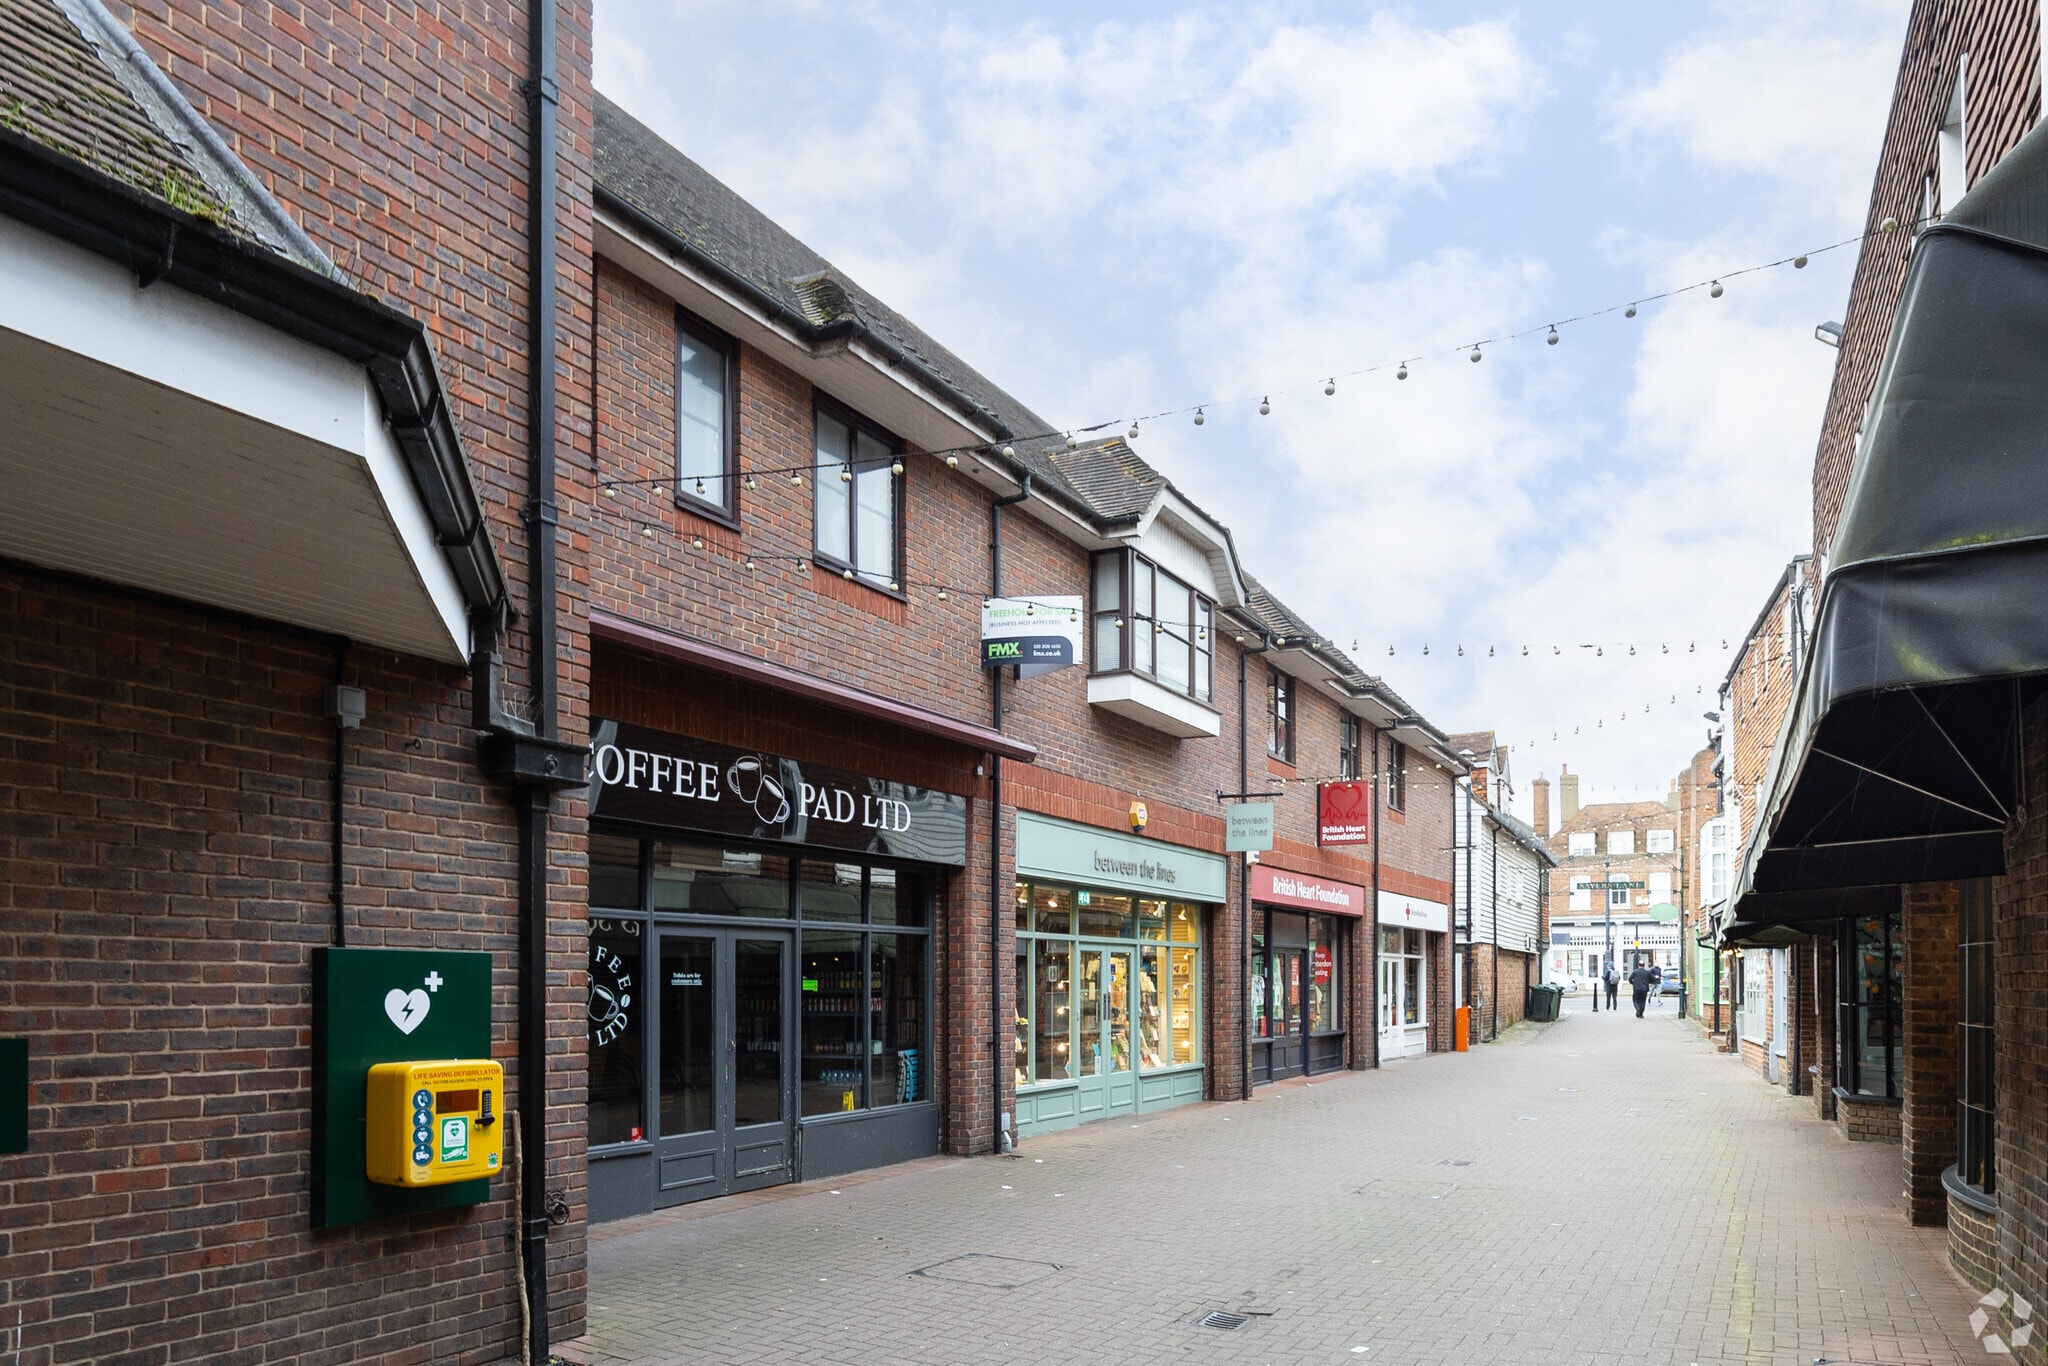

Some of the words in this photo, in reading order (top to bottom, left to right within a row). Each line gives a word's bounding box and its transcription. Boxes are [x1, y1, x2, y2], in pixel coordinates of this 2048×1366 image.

[989, 608, 1030, 618] FREEHOL
[798, 782, 856, 823] PAD
[862, 794, 912, 832] LTD
[1231, 817, 1268, 826] between
[1232, 828, 1246, 837] the
[1248, 828, 1268, 837] lines
[1322, 825, 1345, 834] British
[1345, 825, 1367, 833] Heart
[1322, 833, 1366, 841] Foundation
[1094, 849, 1138, 877] between
[1139, 859, 1155, 880] the
[1156, 861, 1176, 883] lines
[1272, 876, 1296, 897] British
[1296, 880, 1316, 901] Heart
[1315, 884, 1350, 906] Foundation
[1578, 882, 1612, 890] SAYERS
[595, 1012, 628, 1046] LTD
[413, 1072, 428, 1080] LIFE
[428, 1071, 452, 1079] SAVING
[453, 1068, 500, 1077] DEFIBRILLATOR
